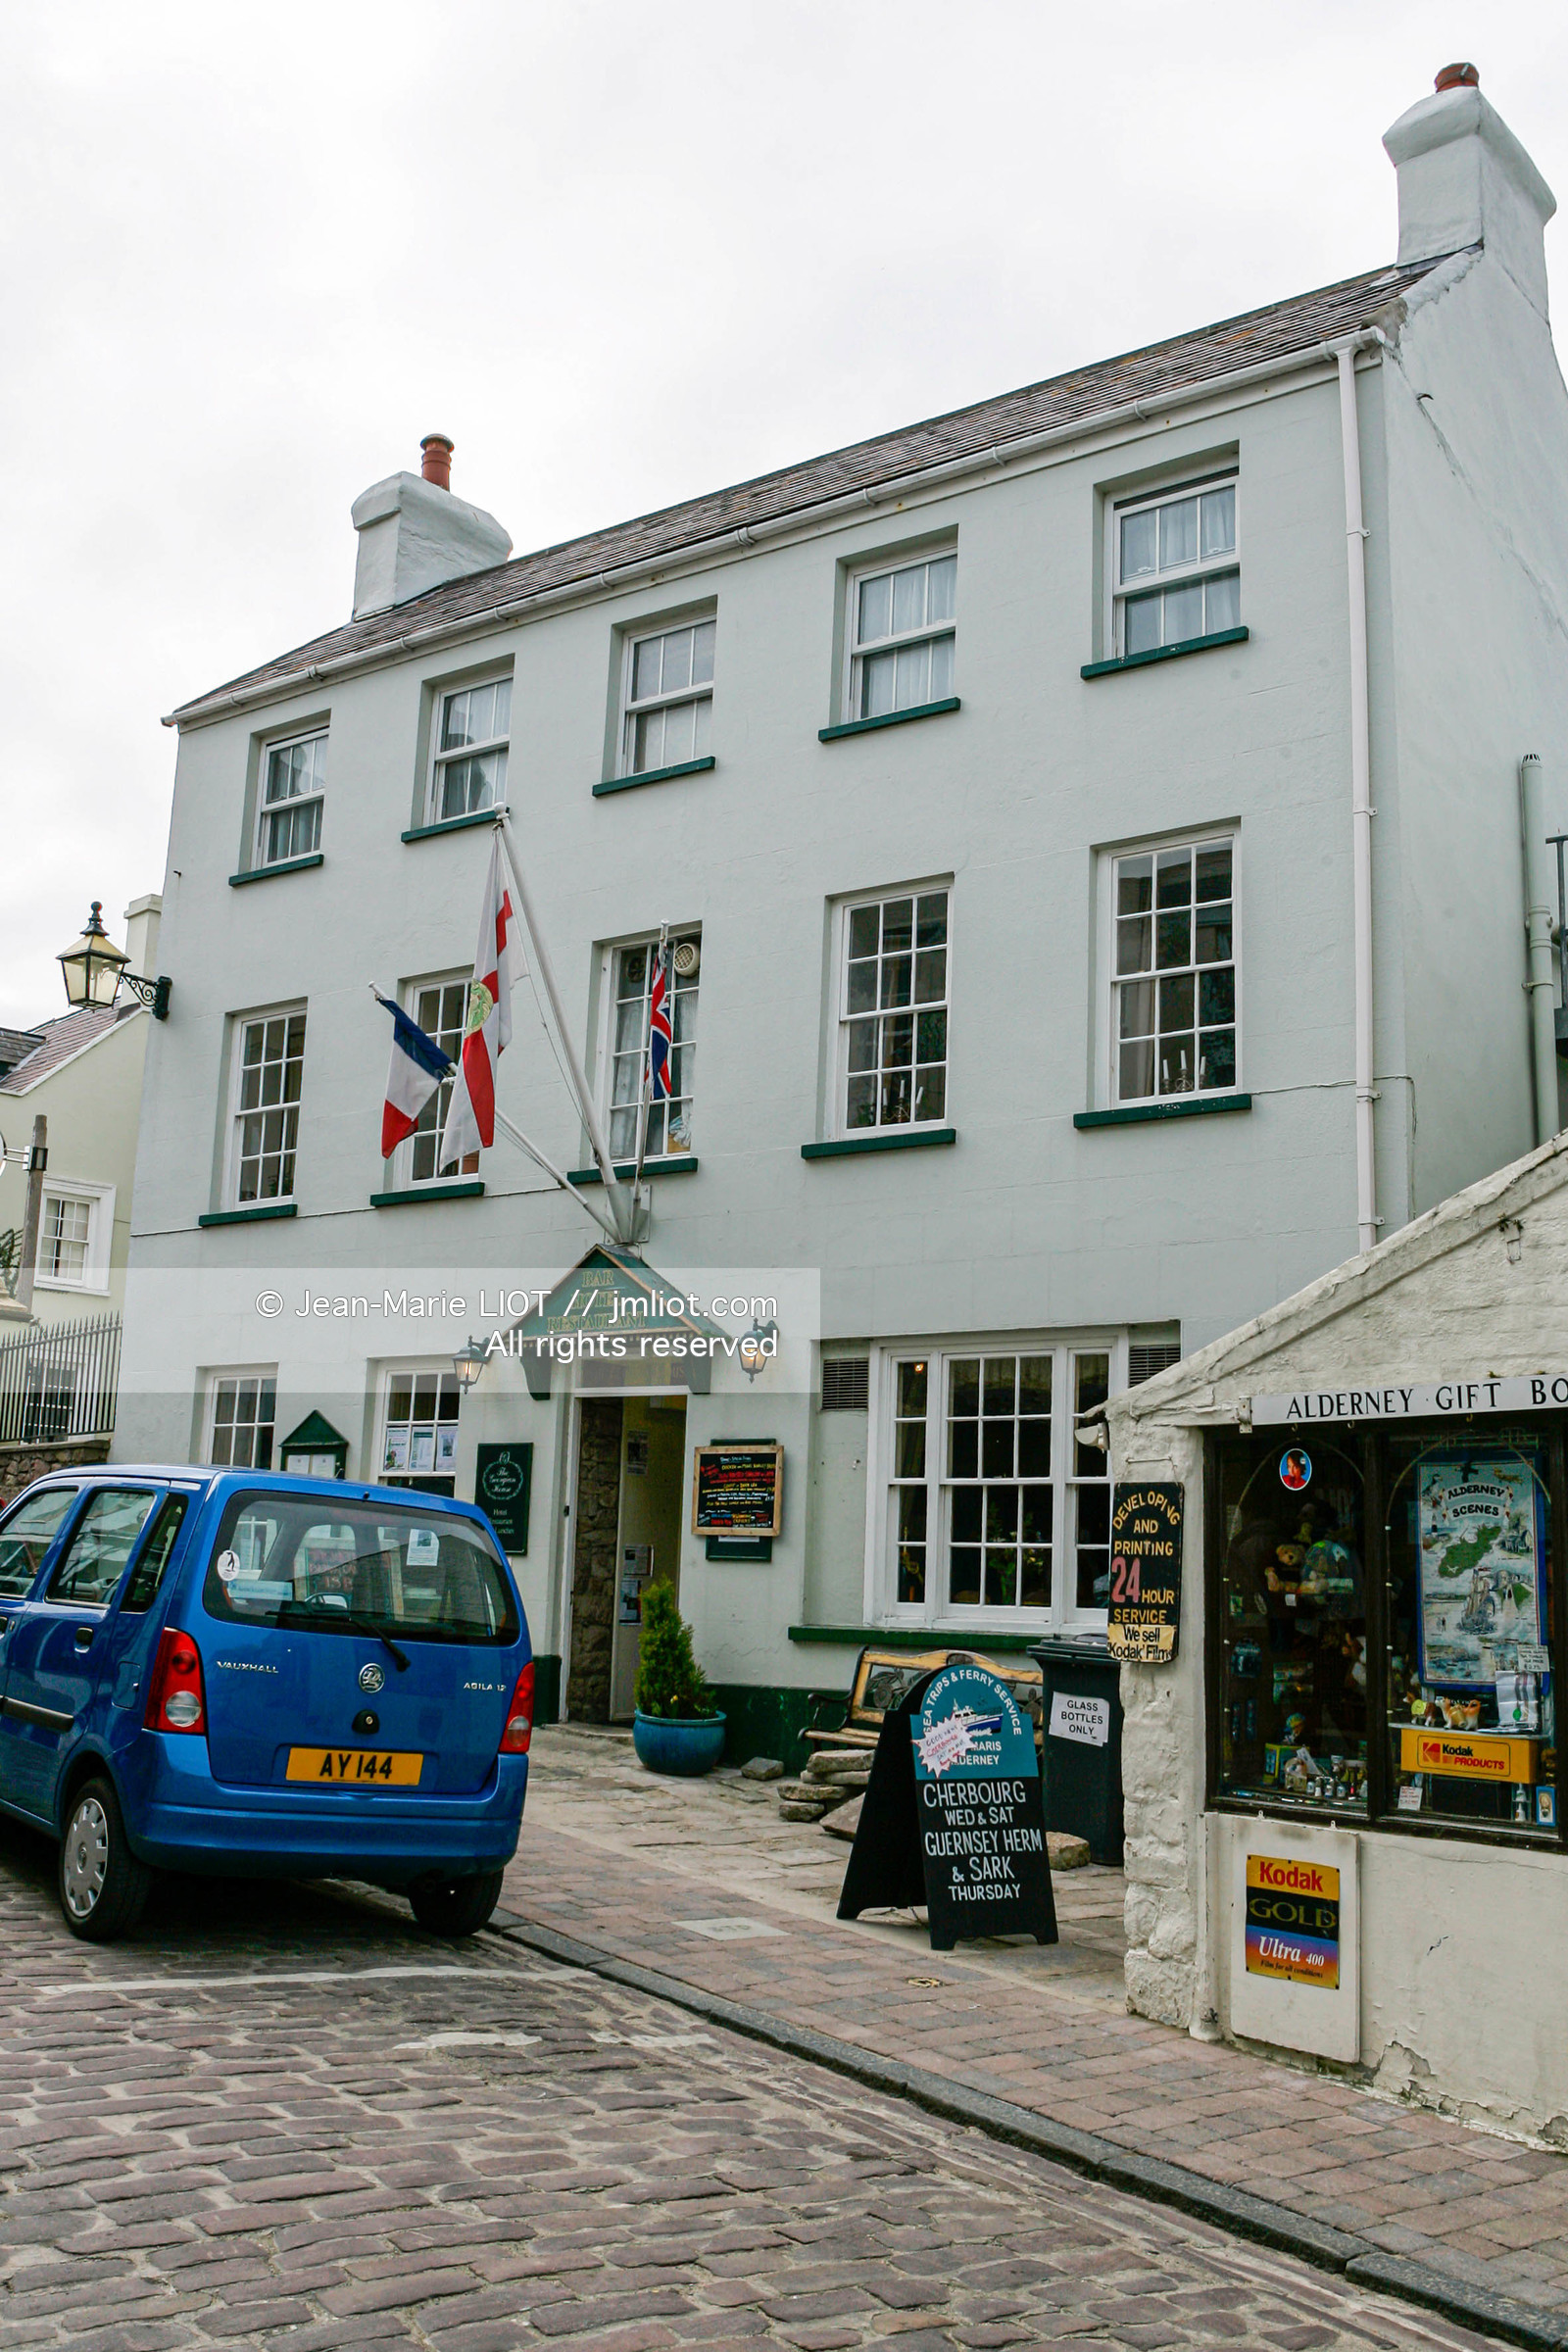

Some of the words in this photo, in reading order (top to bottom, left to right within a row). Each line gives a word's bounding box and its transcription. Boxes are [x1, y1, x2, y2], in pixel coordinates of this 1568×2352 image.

[582, 1270, 614, 1288] BAR
[547, 1311, 646, 1332] RESTAURANT
[1286, 1388, 1414, 1420] ALDERNEY
[1435, 1382, 1501, 1410] GIFT
[1447, 1484, 1505, 1499] ALDERNEY
[1112, 1491, 1181, 1530] DEVELOPING
[1452, 1504, 1499, 1518] SCENES
[1133, 1519, 1158, 1534] AND
[1113, 1540, 1174, 1556] PRINTING
[1111, 1556, 1141, 1604] 24
[1142, 1590, 1175, 1605] HOUR
[1113, 1608, 1168, 1624] SERVICE
[1123, 1625, 1141, 1642] We
[1142, 1627, 1160, 1642] sell
[217, 1660, 279, 1674] VAUXHALL
[464, 1682, 493, 1690] AGILA
[926, 1676, 950, 1706] TRIPS
[951, 1672, 958, 1683] &
[959, 1669, 994, 1688] FERRY
[994, 1684, 1022, 1736] SERVICE
[1067, 1699, 1099, 1712] GLASS
[1060, 1710, 1103, 1726] BOTTLES
[1069, 1724, 1095, 1737] ONLY
[1443, 1743, 1474, 1757] Kodak
[319, 1753, 352, 1778] AY
[356, 1754, 392, 1780] 144
[952, 1755, 1000, 1765] DERNEY
[1453, 1756, 1505, 1771] PRODUCTS
[923, 1781, 1026, 1808] CHERBOURG
[945, 1809, 976, 1826] WED
[977, 1811, 987, 1825] &
[989, 1806, 1014, 1824] SAT
[924, 1830, 999, 1856] GUERNSEY
[1003, 1829, 1043, 1852] HERM
[952, 1866, 965, 1883] &
[969, 1856, 1015, 1882] SARK
[1259, 1861, 1324, 1892] Kodak
[948, 1884, 1021, 1901] THURSDAY
[1249, 1897, 1337, 1929] GOLD
[1258, 1936, 1301, 1963] Ultra
[1305, 1952, 1325, 1967] 400
[1260, 1959, 1274, 1968] Film
